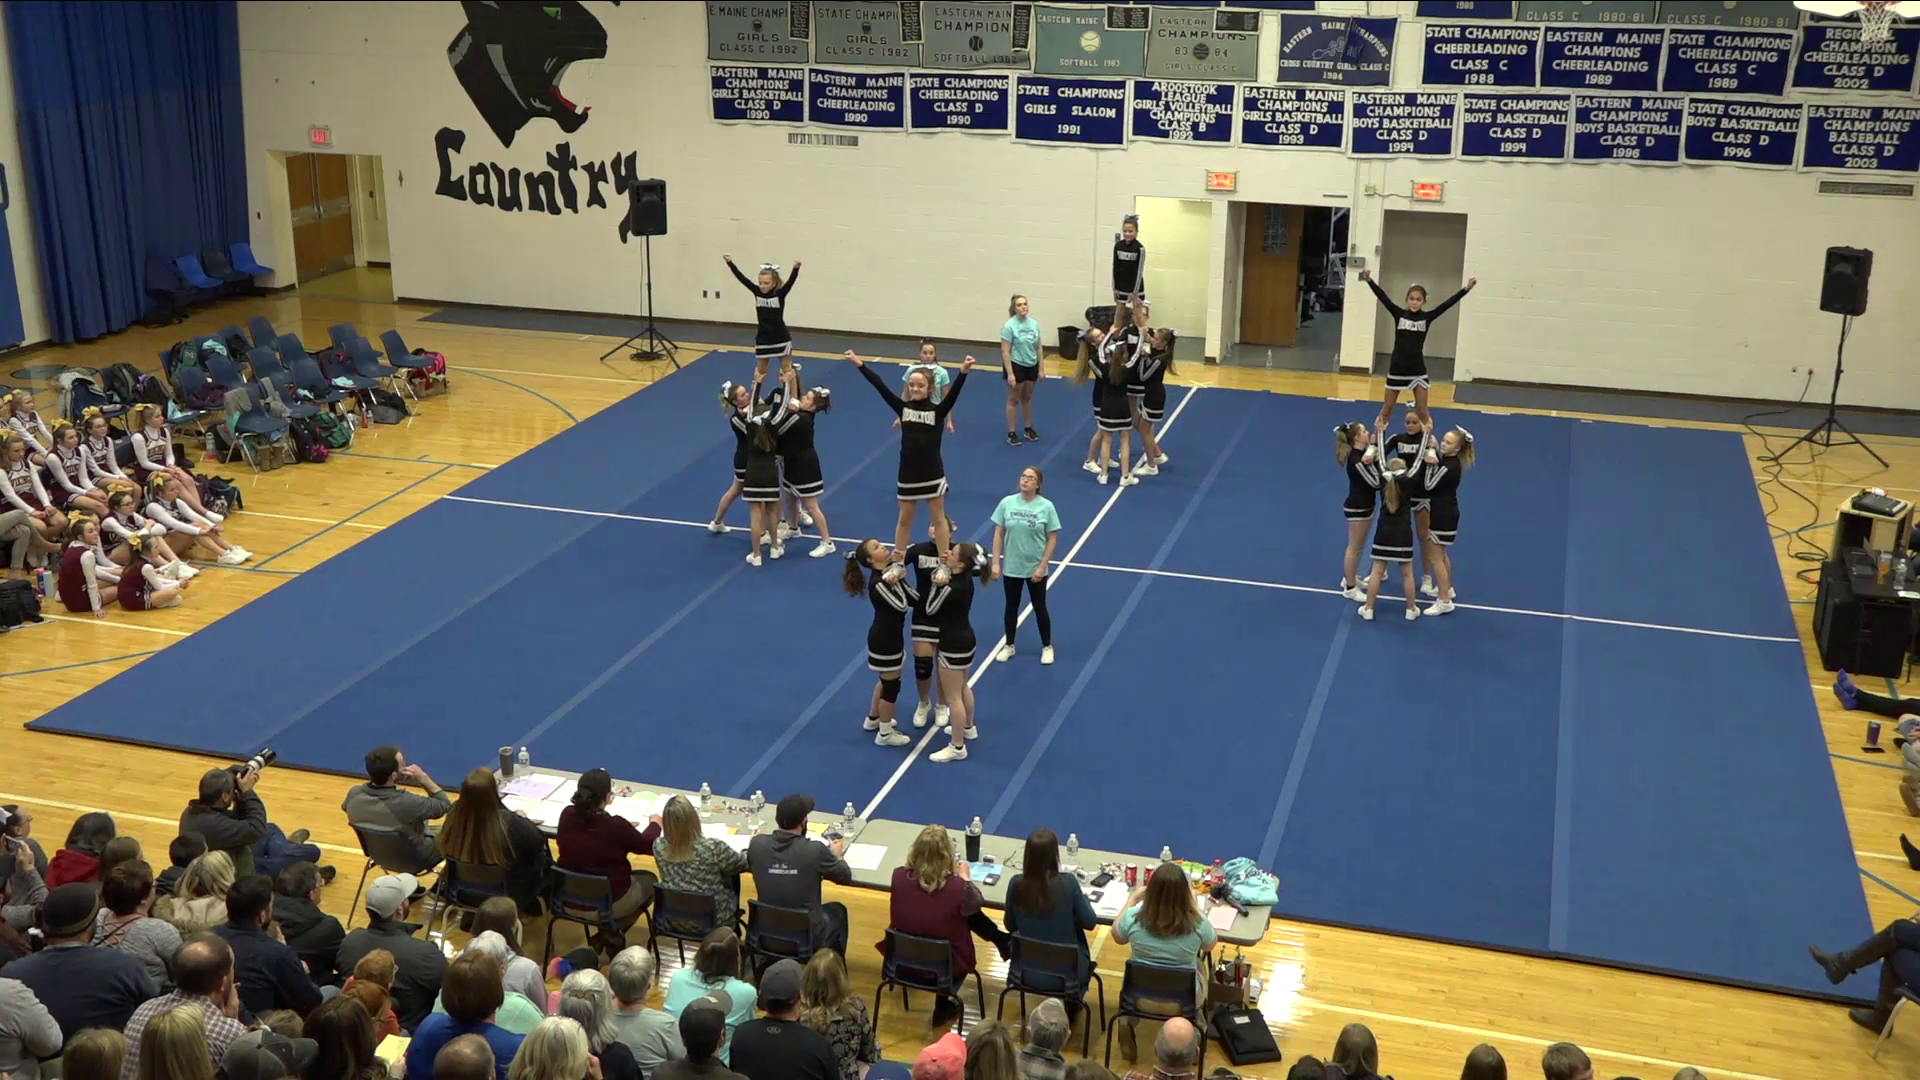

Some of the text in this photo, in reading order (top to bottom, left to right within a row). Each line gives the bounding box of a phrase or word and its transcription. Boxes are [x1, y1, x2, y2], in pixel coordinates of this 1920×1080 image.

[719, 6, 748, 17] MAINE
[818, 8, 851, 19] STATE
[935, 7, 982, 18] EASTERN
[1526, 11, 1563, 20] CLASS
[1572, 12, 1579, 20] C
[1160, 18, 1207, 26] EASTERN
[1667, 14, 1706, 24] CLASS
[1714, 16, 1720, 25] C
[738, 32, 779, 42] GIRLS
[847, 35, 888, 45] GIRLS
[1158, 29, 1247, 41] CHAMPIONS
[1282, 26, 1313, 54] EASTERN
[1321, 22, 1346, 30] MAINE
[1426, 27, 1539, 41] STATE CHAMPIONS
[1546, 31, 1662, 44] EASTERN MAINE
[1825, 28, 1895, 40] REGIL
[1669, 33, 1792, 50] STATE CHAMPIONS
[1820, 40, 1898, 53] CHAMPION
[720, 43, 797, 54] CLASS C 1982
[826, 46, 909, 57] CLASS C 1982
[1175, 46, 1188, 55] 83
[1434, 43, 1528, 55] CHEERLEADING
[1564, 45, 1641, 58] CHAMPIONS
[934, 53, 988, 63] SOFTBALL
[1678, 48, 1778, 62] CHEERLEADING
[1804, 52, 1910, 65] CHEERLEADING
[1060, 58, 1098, 66] SOFTBALL
[1197, 64, 1227, 72] CLASS
[1302, 60, 1334, 69] COUNTRY
[1360, 63, 1382, 71] CLASS
[1450, 59, 1508, 70] CLASS C
[1552, 59, 1649, 72] CHEERLEADING
[711, 68, 804, 80] EASTERN MAINE
[1695, 62, 1757, 76] CLASS C
[1824, 65, 1884, 77] CLASS D
[725, 79, 789, 89] CHAMPIONS
[810, 73, 903, 87] EASTERN MAINE
[910, 78, 1009, 89] STATE CHAMPIONS
[1464, 74, 1494, 84] 1988
[1585, 74, 1613, 85] 1989
[1708, 77, 1738, 88] 1989
[1834, 78, 1869, 88] 2002
[712, 89, 804, 100] GIRLS BASKETBALL
[826, 86, 888, 99] CHAMPIONS
[1018, 85, 1124, 99] STATE CHAMPIONS
[1152, 82, 1218, 95] AROOSTOOK
[1244, 88, 1344, 101] EASTERN MAINE
[918, 89, 999, 101] CHEERLEADING
[1161, 92, 1206, 104] LEAGUE
[1353, 93, 1457, 105] EASTERN MAINE
[734, 100, 781, 110] CLASS D
[817, 98, 895, 112] CHEERLEADING
[934, 102, 983, 113] CLASS D
[1134, 99, 1232, 114] GIRLS VOLLEYBALL
[1257, 100, 1328, 112] CHAMPIONS
[1464, 98, 1569, 111] STATE CHAMPIONS
[1576, 97, 1685, 109] EASTERN MAINE
[746, 110, 770, 119] 1990
[1024, 103, 1116, 118] GIRLS SLALOM
[1366, 106, 1441, 117] CHAMPIONS
[1590, 111, 1669, 122] CHAMPIONS
[1688, 103, 1802, 119] STATE CHAMPIONS
[1809, 106, 1872, 119] EASTERN
[844, 112, 868, 122] 1990
[947, 115, 971, 125] 1990
[1150, 110, 1216, 124] CHAMPIONS
[1243, 110, 1344, 124] GIRLS BASKETBALL
[1464, 112, 1568, 125] BOYS BASKETBALL
[1057, 124, 1080, 135] 1991
[1158, 120, 1206, 132] CLASS B
[1264, 123, 1318, 135] CLASS D
[1353, 118, 1453, 129] BOYS BASKETBALL
[1575, 123, 1680, 135] BOYS BASKETBALL
[1687, 116, 1799, 132] BOYS BASKETBALL
[1823, 120, 1910, 132] CHAMPIONS
[1169, 130, 1193, 140] 1992
[1376, 130, 1428, 140] CLASS D
[1489, 127, 1542, 138] CLASS D
[1712, 131, 1769, 145] CLASS D
[1828, 132, 1900, 144] BASEBALL
[1279, 134, 1304, 144] 1993
[1600, 135, 1655, 146] CLASS D
[1389, 142, 1414, 152] 1994
[1500, 142, 1526, 152] 1994
[1613, 148, 1640, 158] 1996
[1723, 146, 1752, 157] 1996
[1832, 144, 1894, 156] CLASS D
[1844, 157, 1878, 168] 2003
[435, 126, 639, 244] Country
